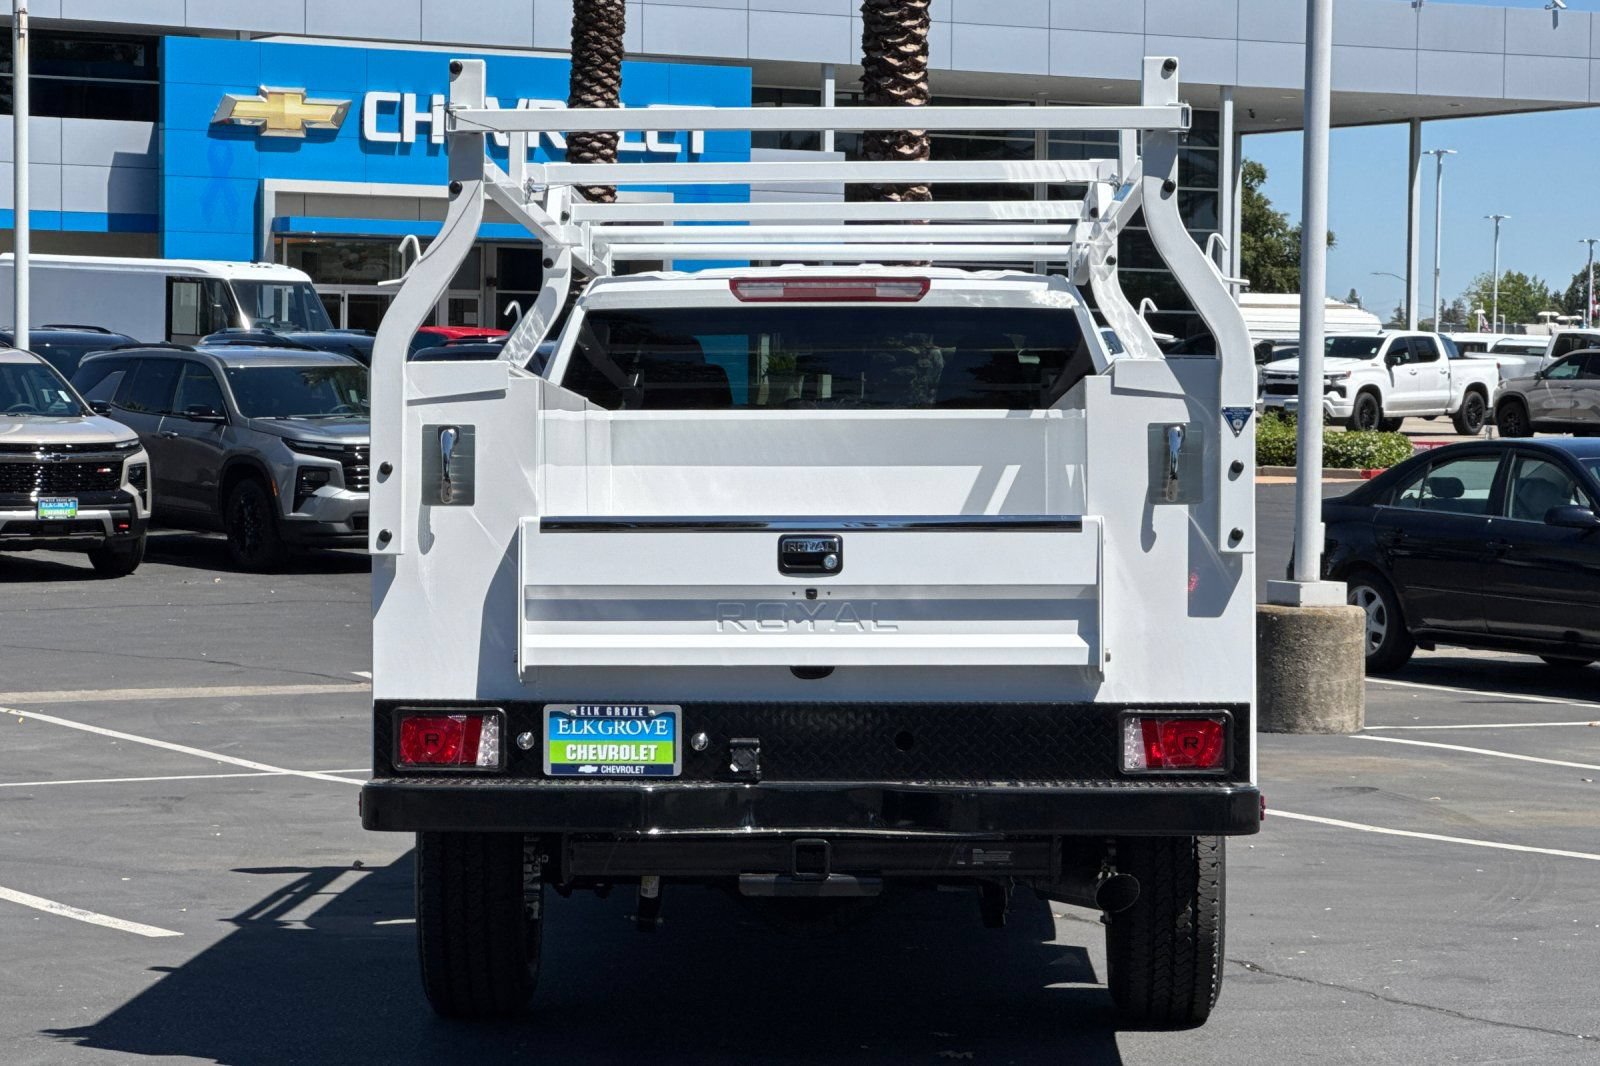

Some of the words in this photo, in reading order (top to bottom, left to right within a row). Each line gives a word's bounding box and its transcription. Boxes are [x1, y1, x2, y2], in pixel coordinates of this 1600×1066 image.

[787, 542, 832, 552] ROYAL
[716, 602, 899, 632] ROYAL
[581, 706, 600, 716] ELK
[606, 706, 643, 716] GROVE
[557, 718, 597, 735] ELK
[598, 718, 668, 735] GROVE
[1184, 737, 1198, 749] R
[566, 743, 658, 761] CHEVROLET
[601, 765, 645, 774] CHEVROLET
